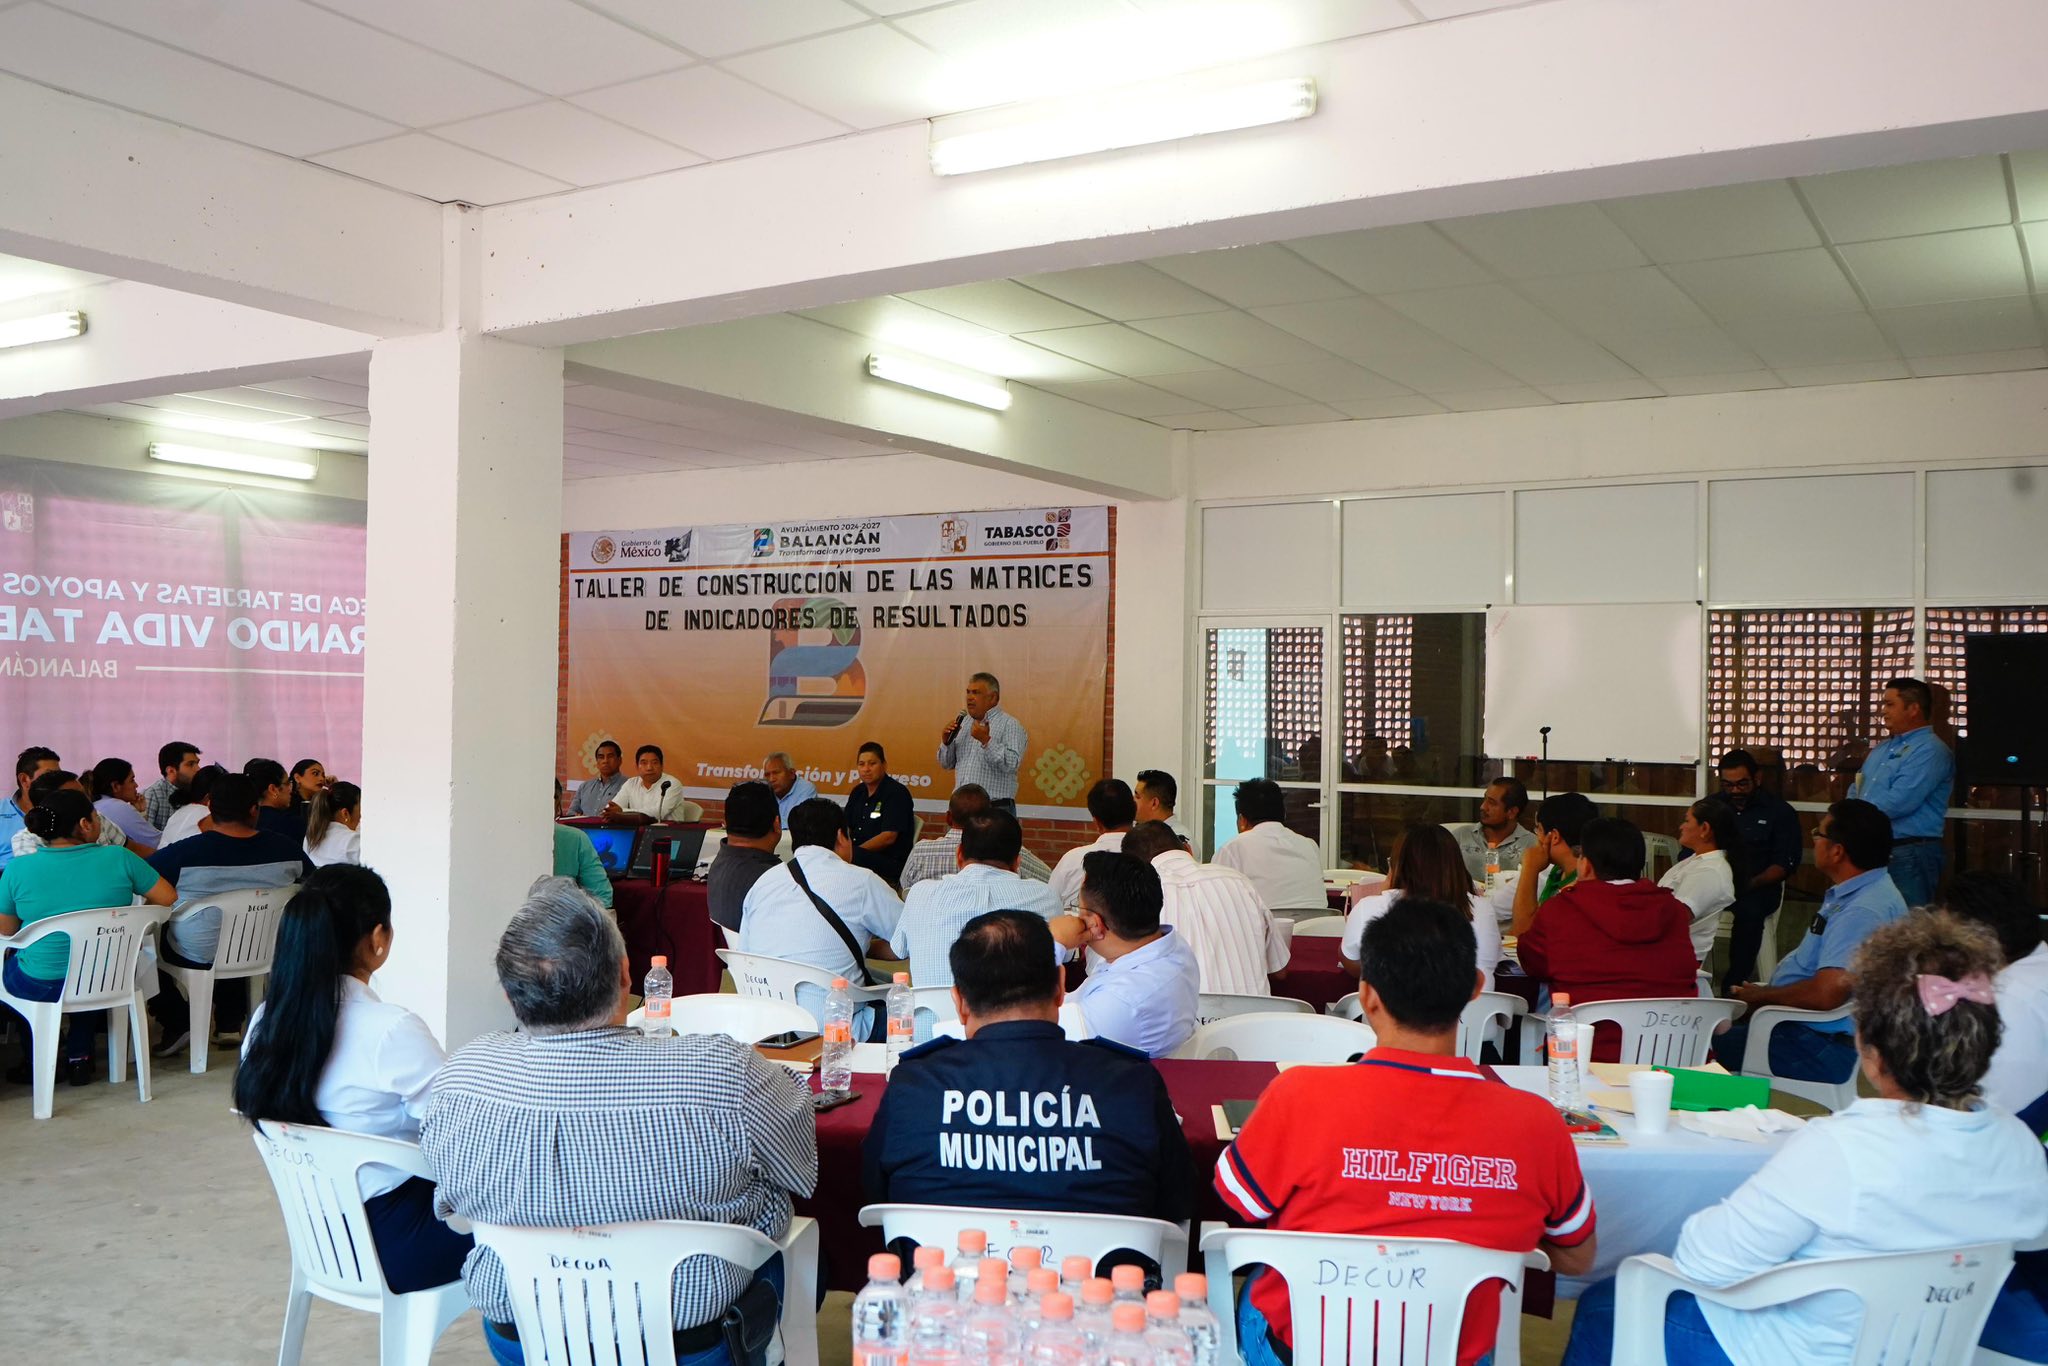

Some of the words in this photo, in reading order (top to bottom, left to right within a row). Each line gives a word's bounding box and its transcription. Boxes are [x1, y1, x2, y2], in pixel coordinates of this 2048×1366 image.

[780, 525, 840, 533] AYUNTAMIENTO
[841, 522, 880, 531] 2024-2027
[984, 525, 1056, 539] TABASCO
[780, 530, 880, 548] BALANCÁN
[620, 546, 661, 558] México
[779, 547, 839, 557] Transformación
[845, 546, 881, 556] Progreso
[575, 577, 645, 599] TALLER
[659, 576, 683, 597] DE
[697, 563, 852, 596] CONSTRUCCIÓN
[867, 570, 894, 593] DE
[910, 568, 953, 591] LAS
[970, 563, 1092, 590] MATRICES
[645, 610, 669, 630] DE
[684, 607, 816, 630] INDICADORES
[831, 606, 858, 629] DE
[873, 604, 1027, 628] RESULTADOS
[833, 771, 846, 786] y
[1641, 1011, 1703, 1031] DECUR
[942, 1085, 1101, 1128] POLICÍA
[939, 1132, 1102, 1173] MUNICIPAL
[1341, 1147, 1518, 1190] HILFIGER
[1388, 1191, 1428, 1209] NEW
[1428, 1195, 1472, 1212] YORK
[1313, 1259, 1426, 1290] DECUR
